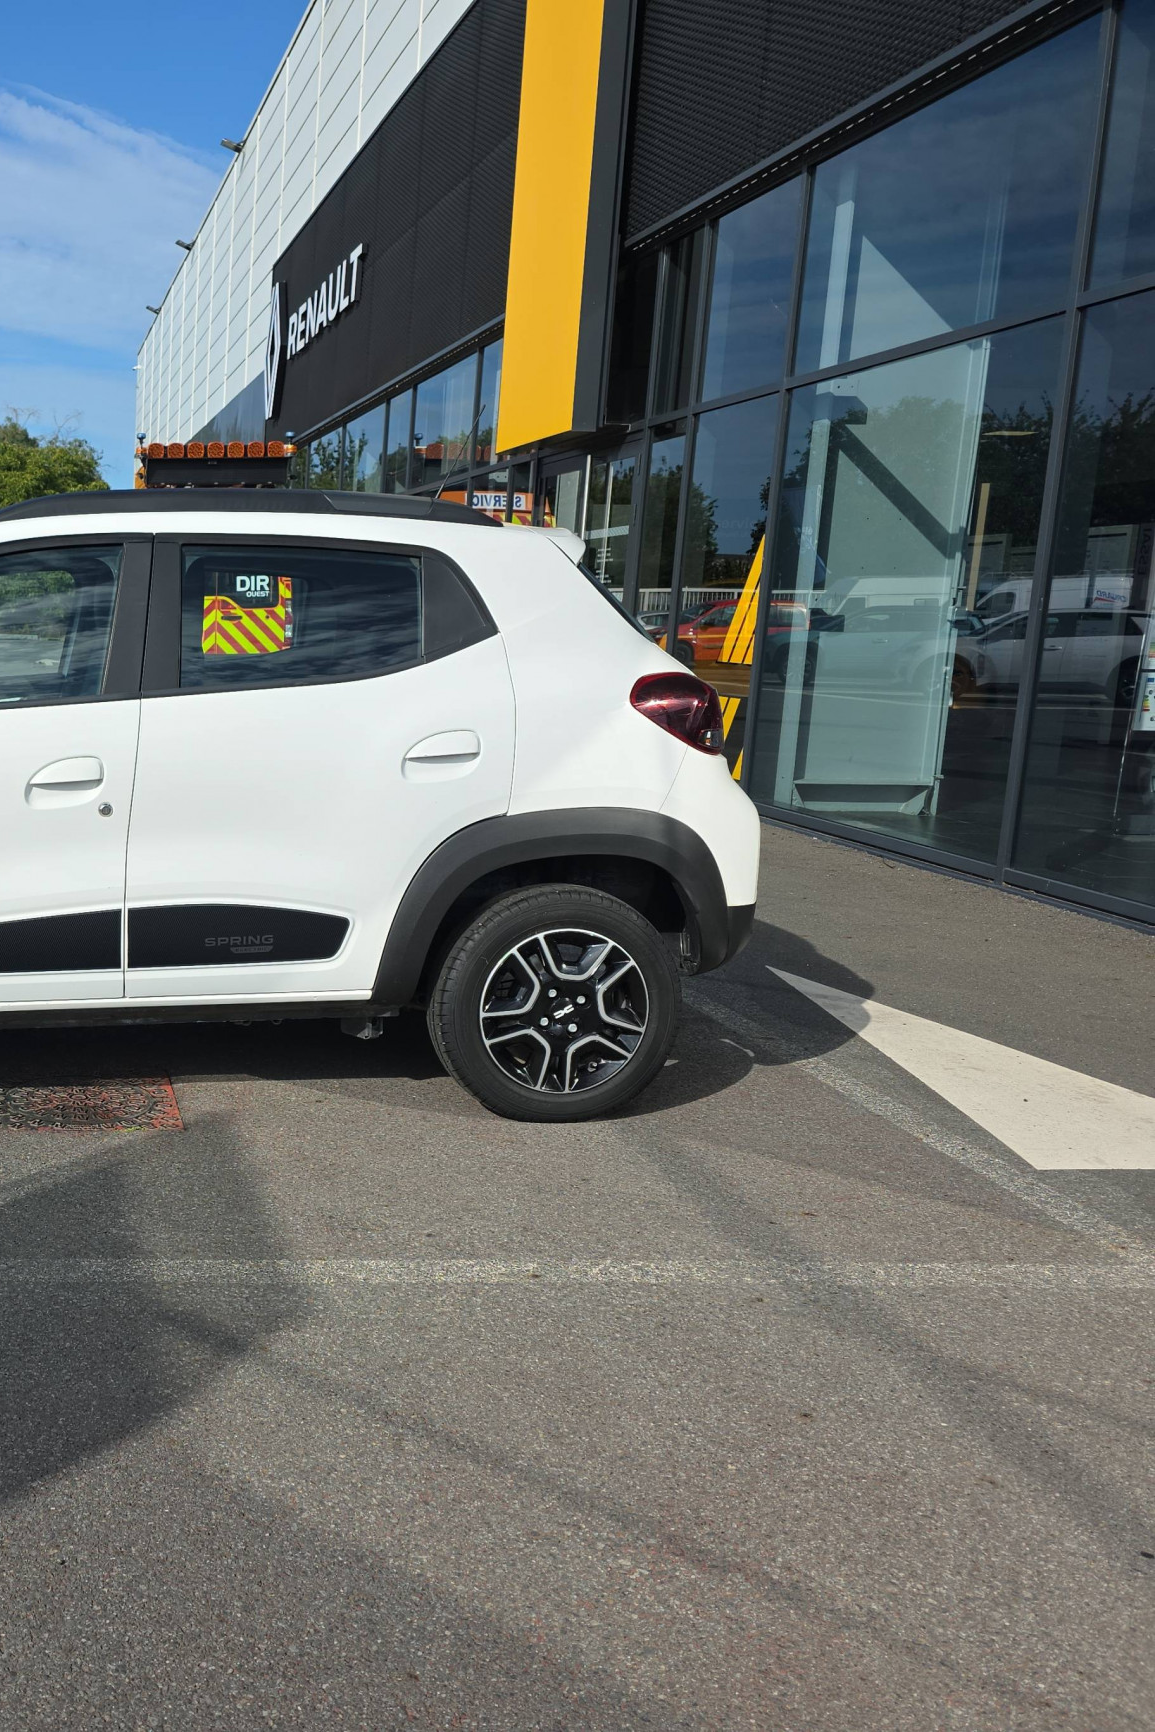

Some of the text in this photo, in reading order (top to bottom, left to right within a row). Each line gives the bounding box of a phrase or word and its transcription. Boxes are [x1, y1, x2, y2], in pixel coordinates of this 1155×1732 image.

[287, 243, 363, 360] RENAULT
[236, 575, 270, 592] DIR
[246, 590, 270, 598] OUEST
[205, 935, 274, 947] SPRING
